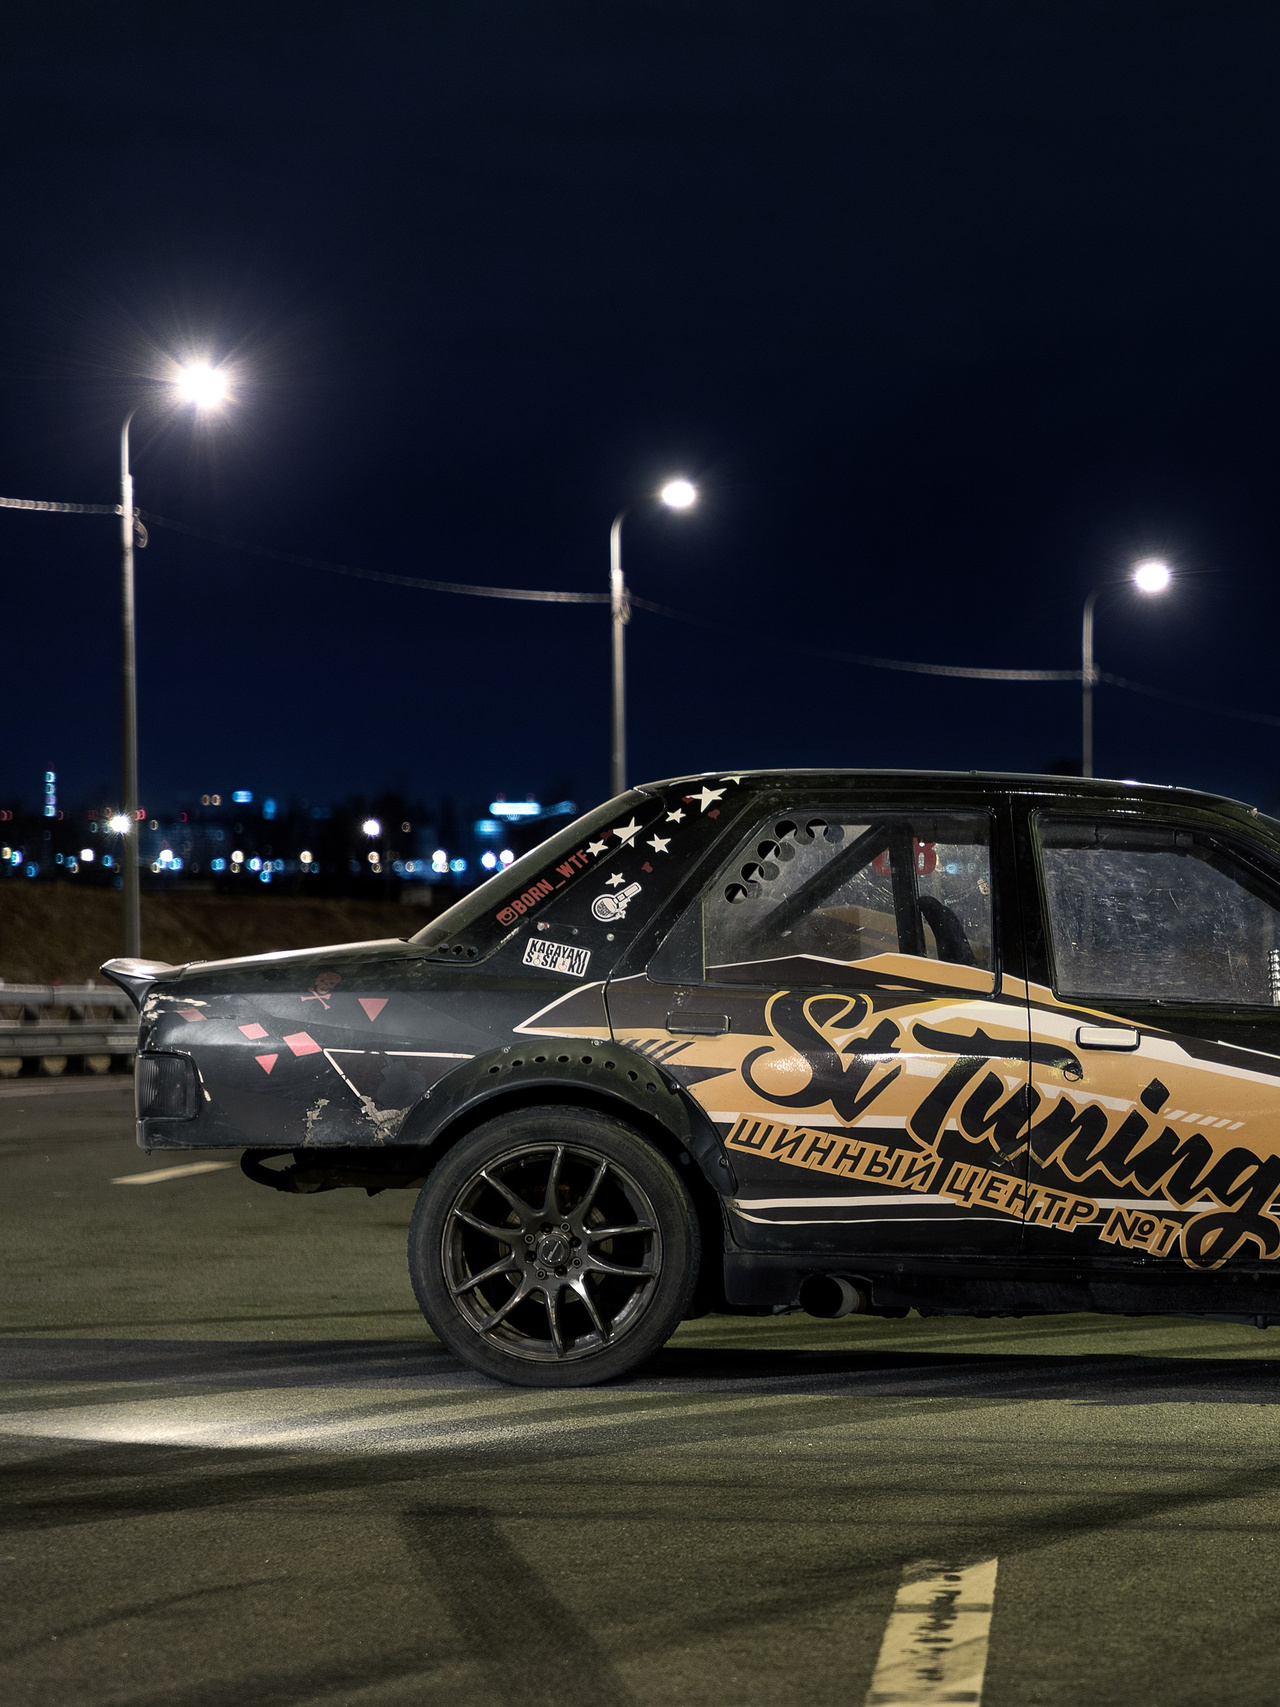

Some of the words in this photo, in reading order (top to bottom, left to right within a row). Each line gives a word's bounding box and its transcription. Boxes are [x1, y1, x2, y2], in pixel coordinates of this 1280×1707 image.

[511, 849, 588, 914] BORN_WTF
[530, 940, 588, 963] KAGAYAKI
[726, 1112, 942, 1194] ШИННЫЙ
[944, 1160, 1101, 1232] ЦЕНТР
